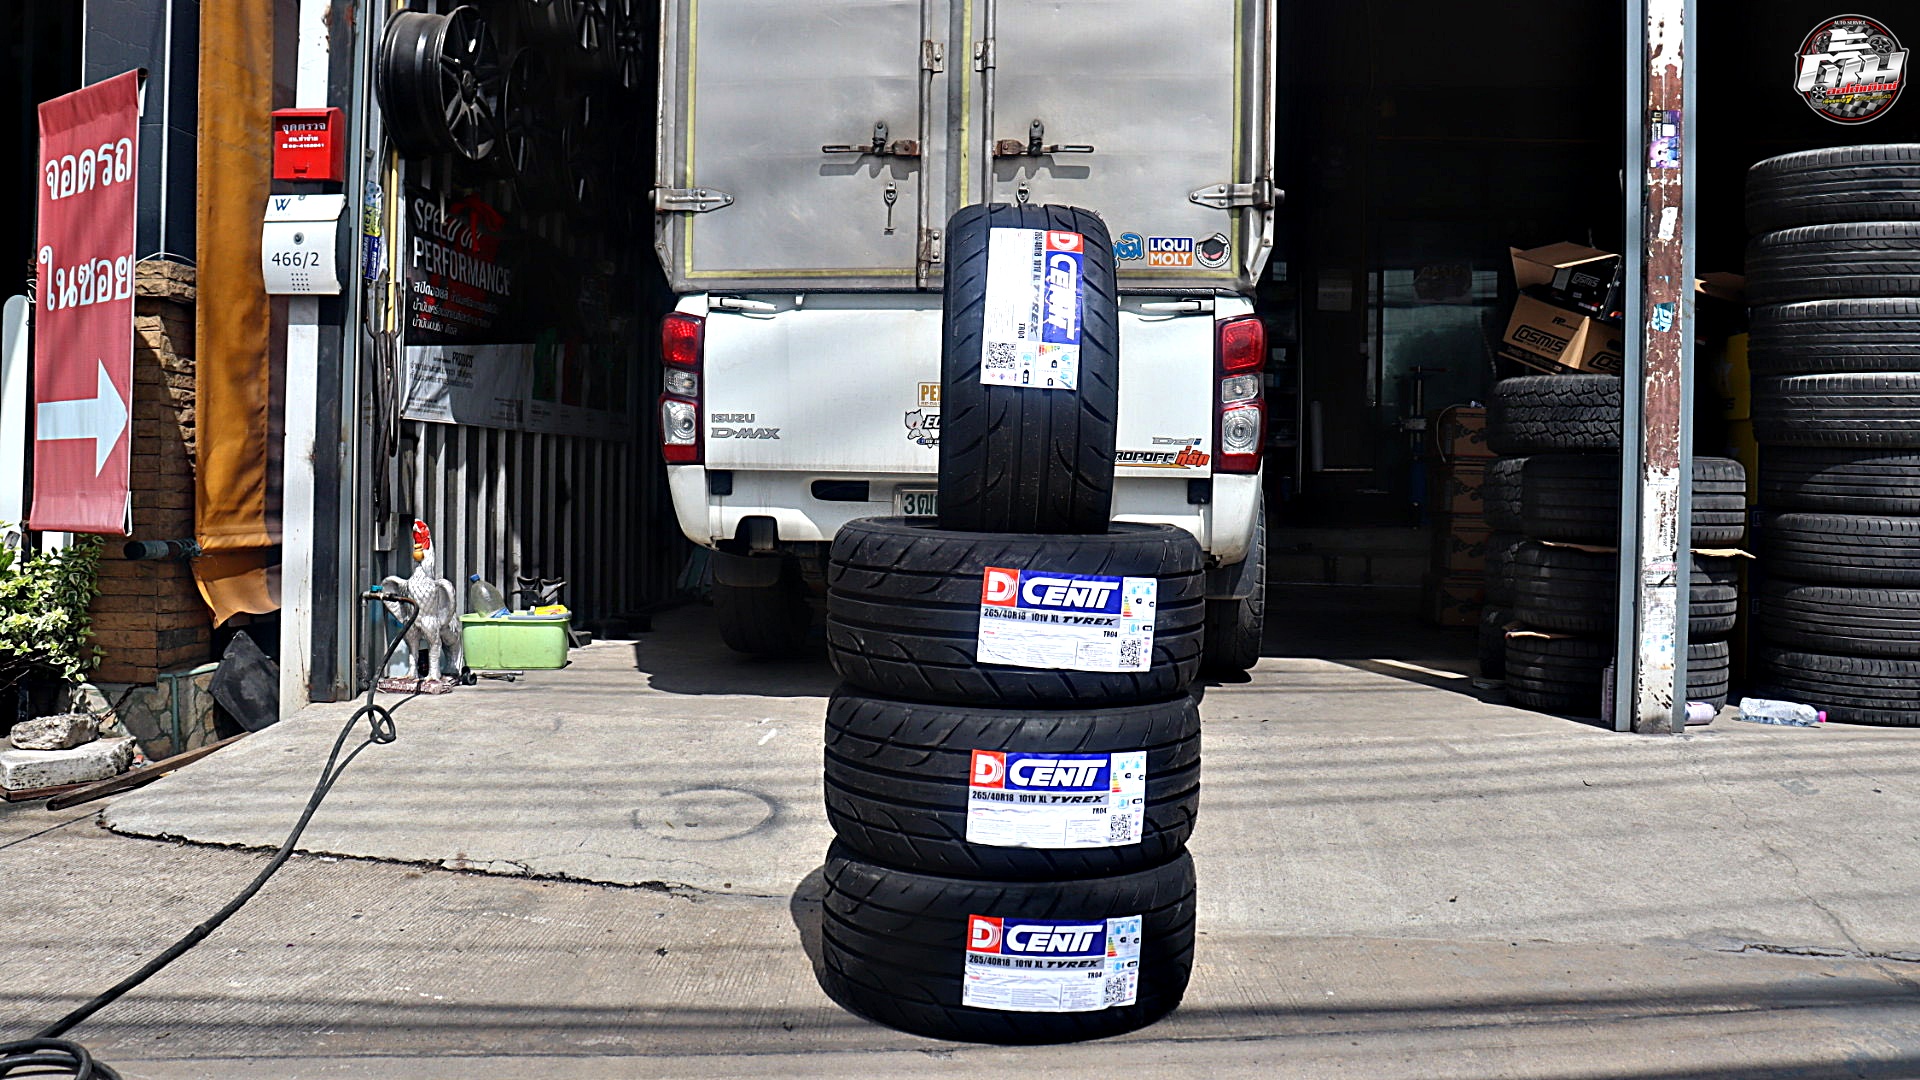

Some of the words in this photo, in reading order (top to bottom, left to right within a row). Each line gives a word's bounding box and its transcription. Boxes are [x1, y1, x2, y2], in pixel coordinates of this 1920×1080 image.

[45, 137, 133, 200] จอดรถ
[1150, 239, 1190, 251] LIQUI
[271, 251, 319, 269] 466/2
[413, 235, 511, 297] PERFORMANCE
[1150, 253, 1191, 265] MOLY
[39, 245, 133, 311] ในซอย
[1018, 322, 1026, 339] TR04
[711, 413, 756, 423] ISUZU
[711, 427, 781, 440] D-MAX
[984, 608, 1026, 620] 265/40R18
[1031, 613, 1048, 622] 101V
[1050, 614, 1059, 623] XL
[1063, 616, 1117, 626] TYREX
[1103, 630, 1118, 638] TR04
[972, 790, 1014, 802] 265/40R18
[1019, 794, 1036, 802] 101V
[1038, 795, 1047, 803] XL
[1051, 795, 1105, 804] TYREX
[969, 954, 1010, 967] 265/40R18
[1015, 959, 1032, 968] 101V
[1034, 960, 1043, 968] XL
[1047, 960, 1099, 968] TYREX
